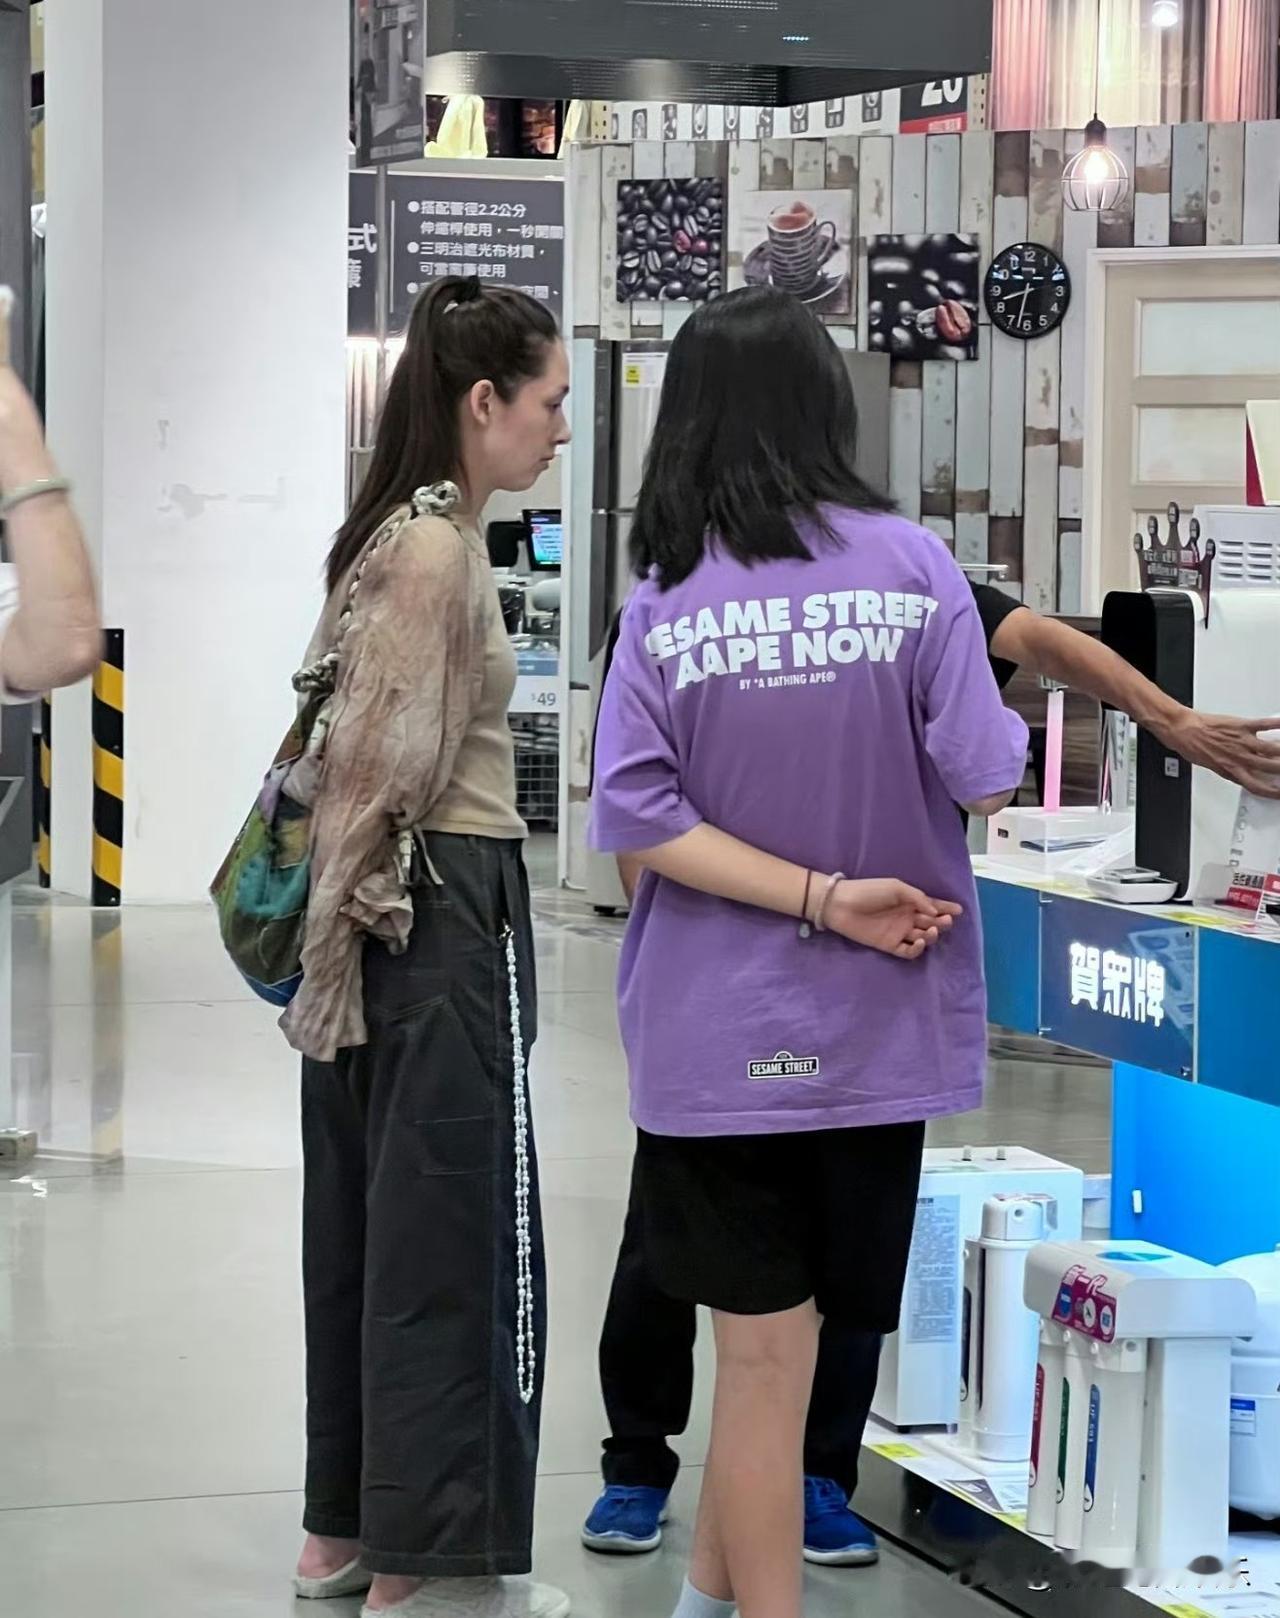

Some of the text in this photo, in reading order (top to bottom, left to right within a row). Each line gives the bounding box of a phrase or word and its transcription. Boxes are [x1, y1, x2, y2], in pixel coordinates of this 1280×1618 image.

[1024, 251, 1035, 262] 12
[1043, 255, 1048, 266] 1
[992, 286, 1001, 296] 9
[1055, 286, 1064, 297] 3
[996, 302, 1006, 313] 8
[1051, 303, 1058, 312] 4
[1007, 315, 1015, 326] 7
[1023, 320, 1031, 331] 6
[1039, 315, 1047, 326] 5
[802, 590, 939, 630] STREET
[675, 627, 904, 690] AAPE NOW
[739, 679, 751, 690] BY
[767, 673, 807, 688] BATHING
[752, 1063, 783, 1075] SESAME
